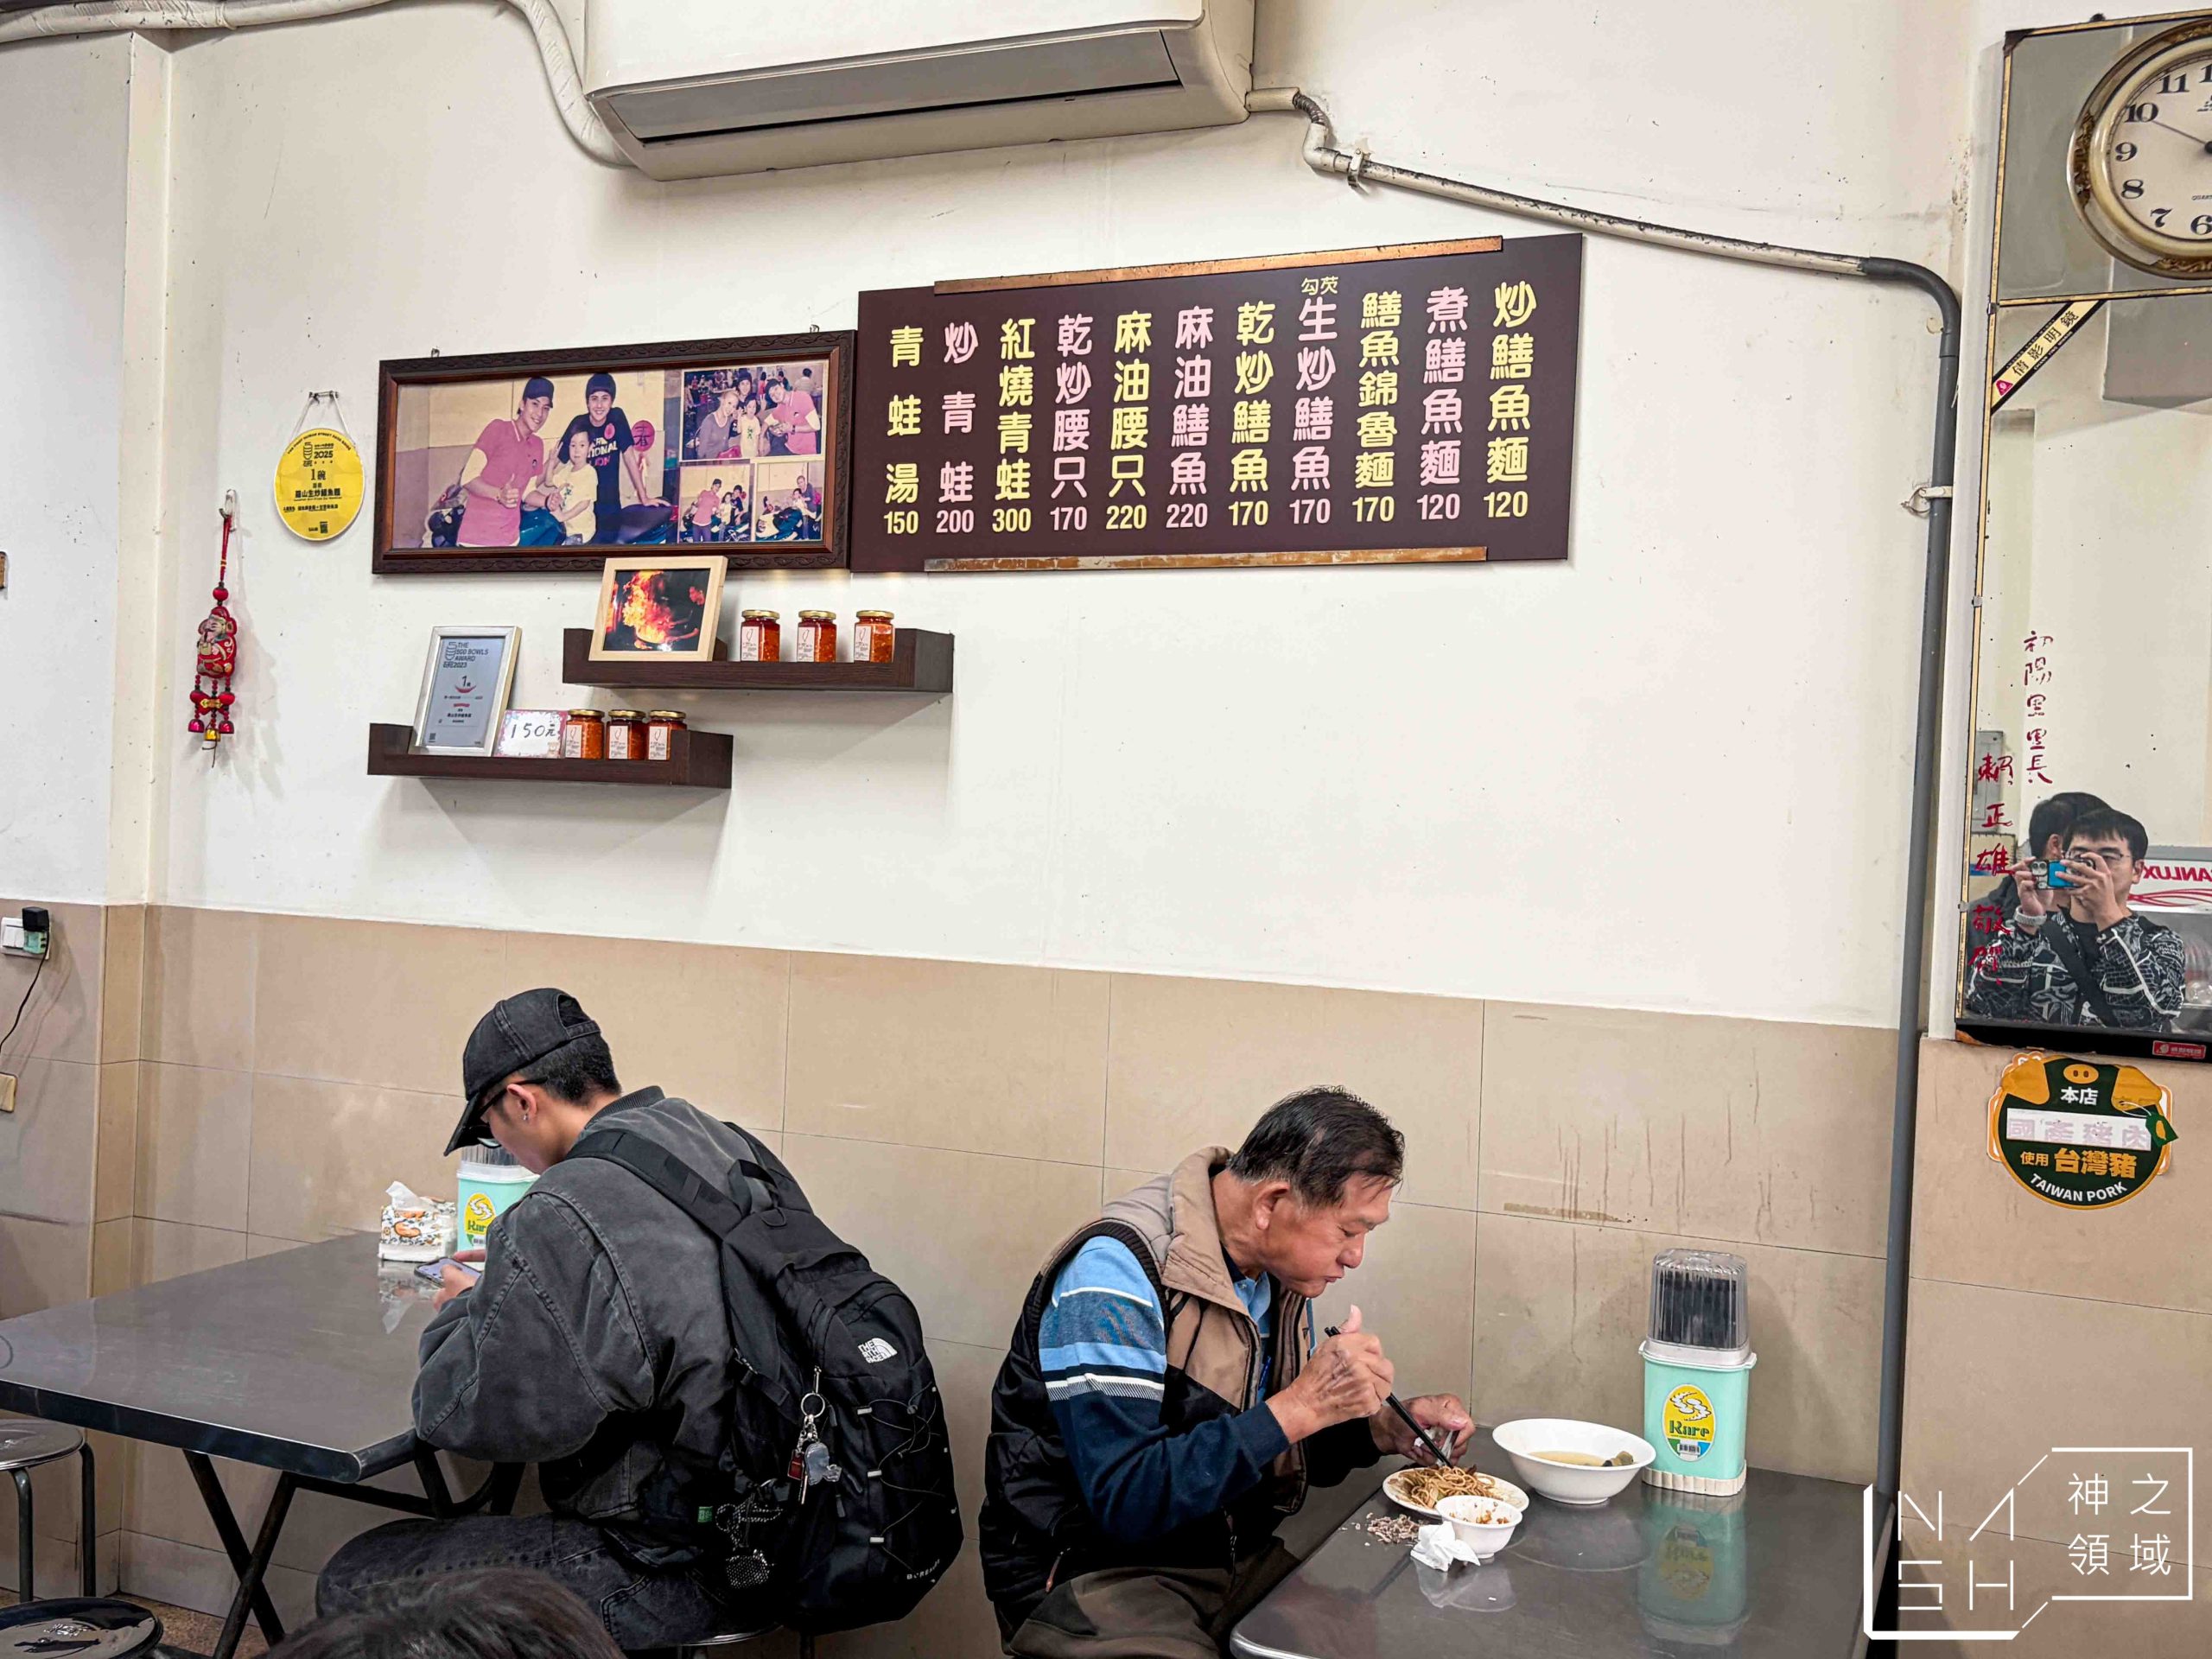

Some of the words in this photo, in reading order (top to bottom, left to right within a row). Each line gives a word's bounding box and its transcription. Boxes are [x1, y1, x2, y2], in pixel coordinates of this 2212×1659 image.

[2157, 73, 2190, 94] 11
[2124, 102, 2159, 123] 10
[2115, 142, 2138, 162] 9
[2121, 179, 2144, 200] 8
[2150, 208, 2172, 228] 7
[2190, 214, 2212, 235] 6
[1290, 296, 1337, 491] 生炒鱔魚
[1420, 286, 1468, 486] 煮鱔魚麵
[1484, 281, 1537, 484] 炒鱔魚麵
[1051, 313, 1094, 499] 乾炒腰只
[1109, 310, 1152, 498] 麻油腰只
[1169, 305, 1214, 495] 麻油鱔魚
[1230, 300, 1276, 493] 乾炒鱔魚
[885, 325, 924, 504] 青蛙湯
[938, 321, 978, 503] 炒青蛙
[995, 318, 1035, 501] 紅燒青蛙
[314, 450, 333, 459] 2025
[1166, 504, 1208, 528] 220
[1228, 500, 1268, 526] 170
[1289, 499, 1331, 524] 170
[1352, 496, 1395, 523] 170
[1417, 493, 1460, 520] 120
[1484, 490, 1529, 518] 120
[884, 511, 918, 534] 150
[936, 510, 975, 533] 200
[992, 508, 1032, 532] 300
[1050, 506, 1088, 531] 170
[1106, 505, 1147, 530] 220
[511, 722, 556, 739] 150元
[2060, 1086, 2098, 1106] 本店
[2020, 1151, 2050, 1167] 使用
[2054, 1147, 2137, 1179] 台灣豬
[2030, 1173, 2083, 1202] TAIWAN
[2086, 1181, 2128, 1202] PORK
[1669, 1420, 1710, 1438] Rare
